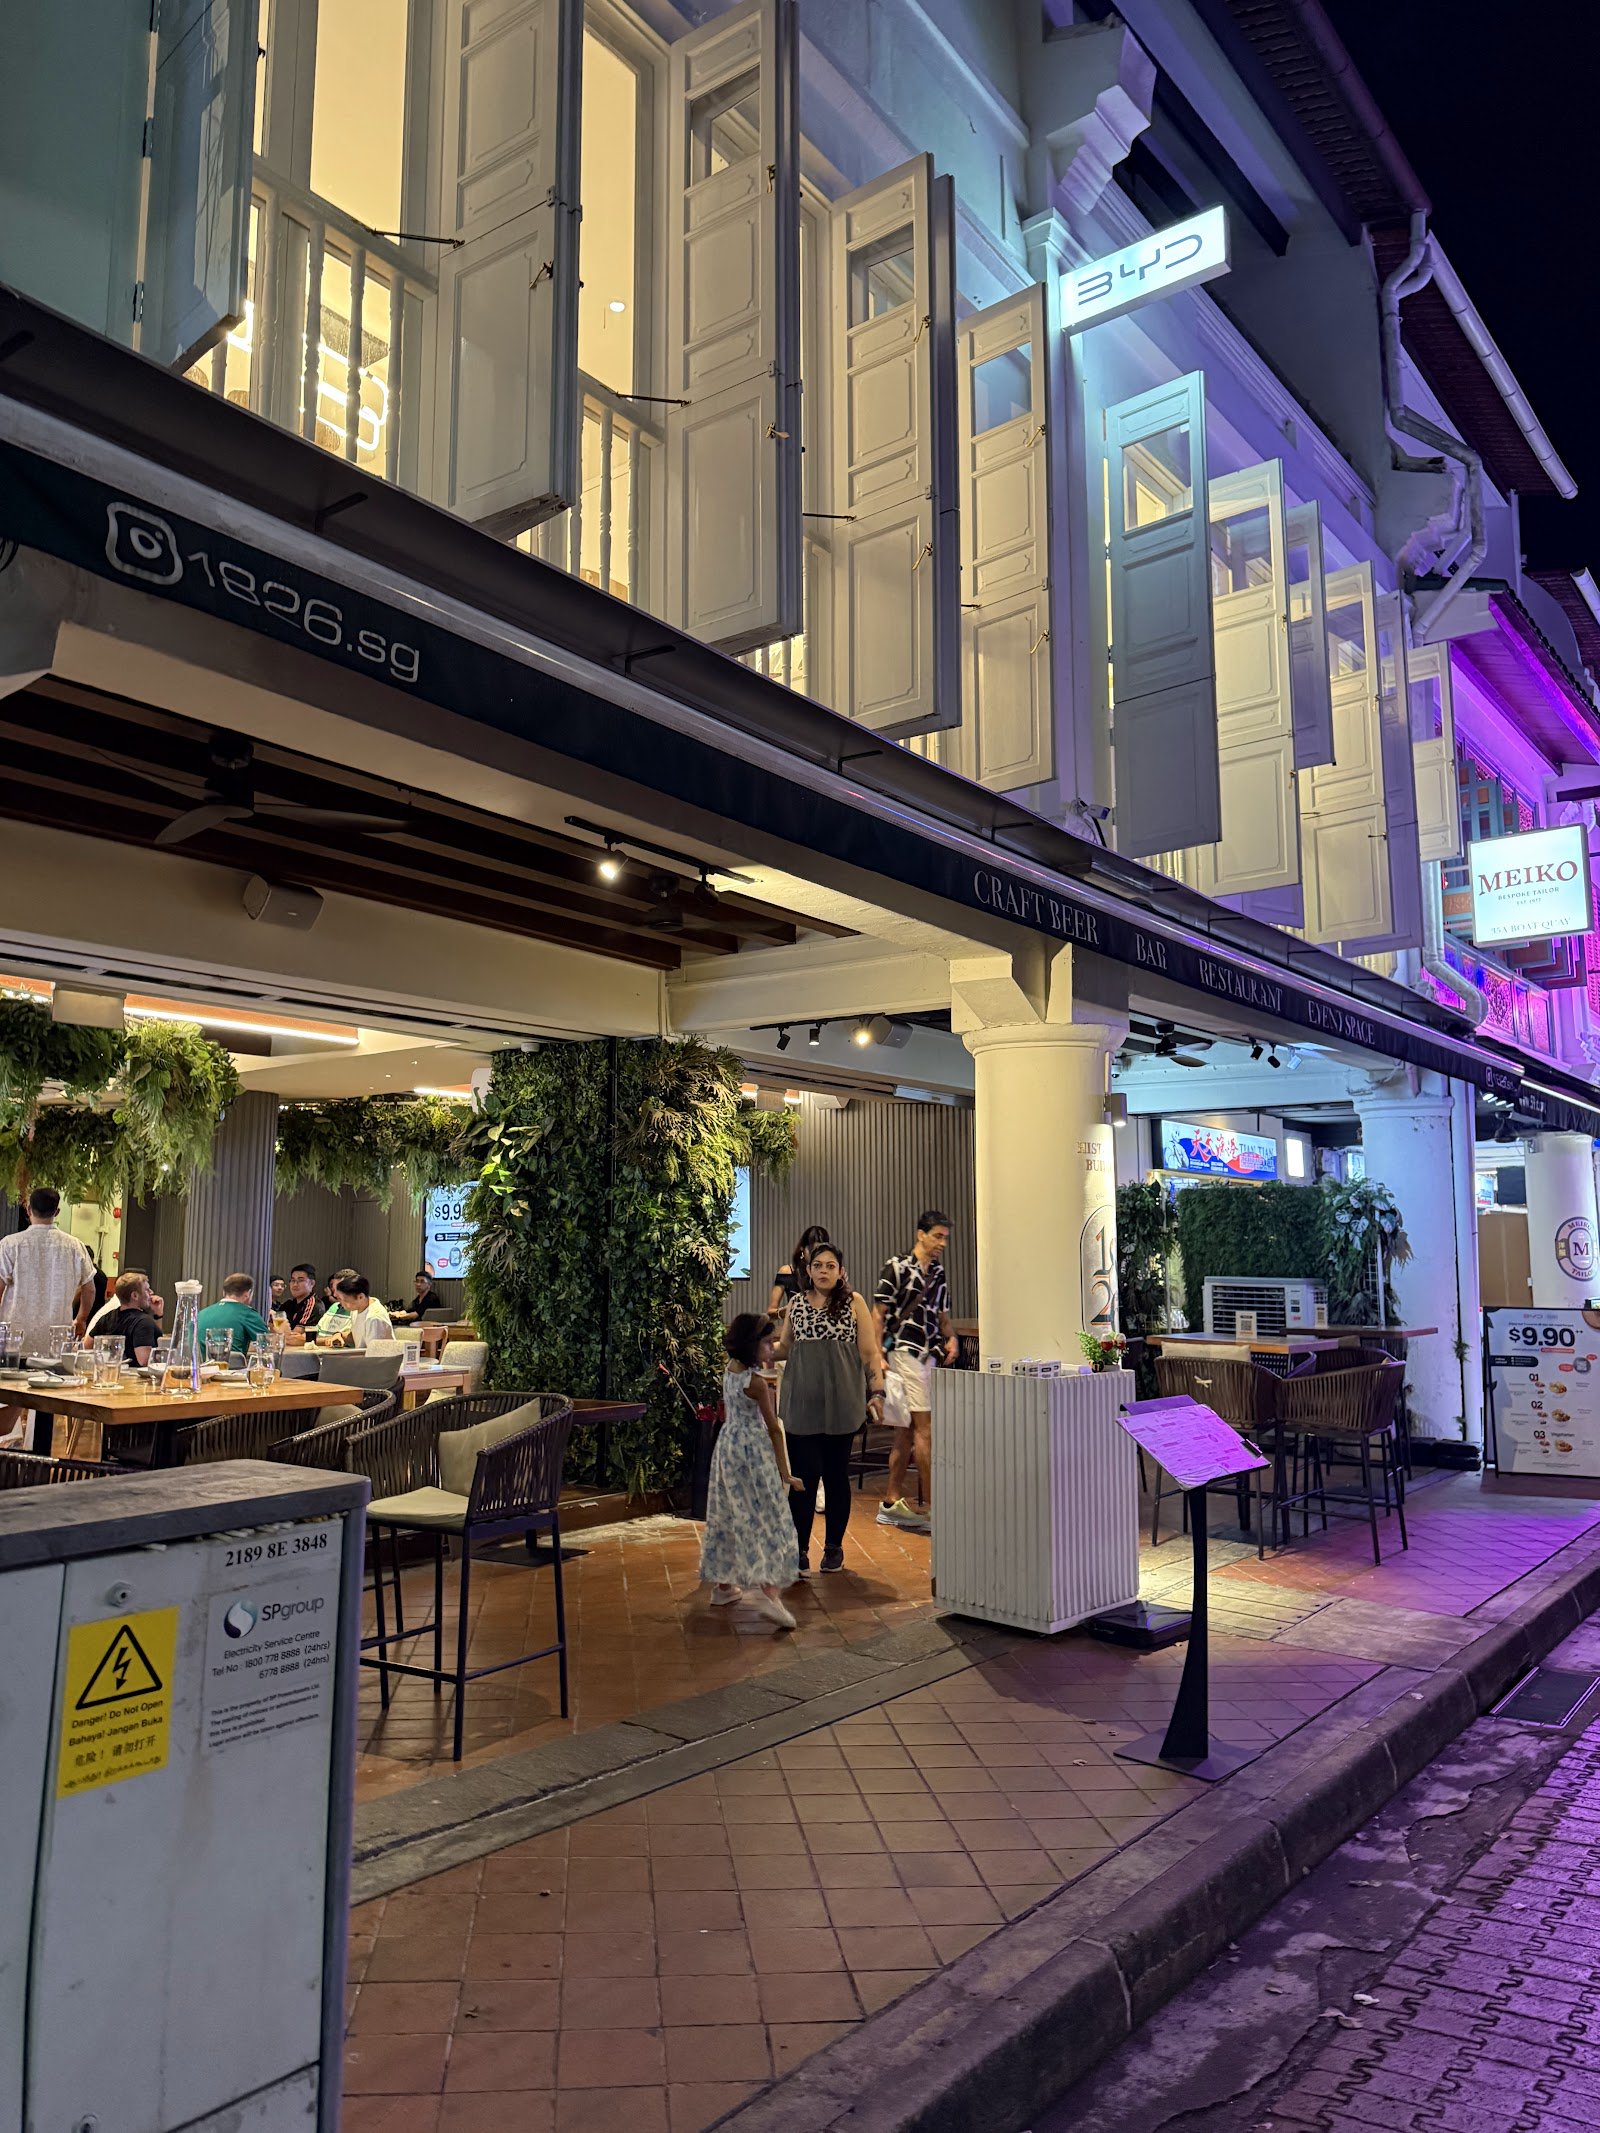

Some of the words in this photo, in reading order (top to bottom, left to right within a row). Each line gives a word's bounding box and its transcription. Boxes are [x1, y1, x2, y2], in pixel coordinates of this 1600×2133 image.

[1077, 233, 1203, 307] BYD
[187, 551, 420, 683] 1826.sg
[1477, 860, 1578, 897] MEIKO
[1498, 889, 1531, 901] BESPOKE
[1533, 886, 1560, 896] TAILOR
[974, 870, 1045, 925] CRAFT
[1049, 898, 1100, 945] BEER
[1135, 932, 1168, 970] BAR
[1199, 958, 1284, 1013] RESTAURANT
[1344, 1014, 1376, 1045] SPACE
[1573, 1242, 1589, 1256] M
[1531, 1400, 1543, 1409] 02
[1533, 1430, 1546, 1439] 03
[225, 1545, 263, 1567] 2189
[267, 1541, 288, 1559] 8E
[292, 1533, 328, 1554] 3848
[212, 1667, 224, 1677] Tel
[226, 1664, 238, 1673] No
[245, 1656, 263, 1668] 1800
[265, 1654, 279, 1662] 778
[281, 1648, 301, 1660] 8888
[304, 1641, 330, 1655] (24hrs)
[223, 1644, 262, 1660] Electricity
[264, 1636, 293, 1650] Service
[295, 1630, 320, 1642] Centre
[259, 1667, 279, 1679] 6778
[280, 1662, 300, 1674] 8888
[303, 1653, 330, 1669] (24hrs)
[71, 1712, 107, 1729] Danger!
[109, 1710, 122, 1719] Do
[123, 1705, 139, 1715] Not
[141, 1700, 164, 1712] Open
[68, 1729, 105, 1747] Bahaya!
[107, 1722, 139, 1737] Jangan
[141, 1716, 163, 1728] Buka
